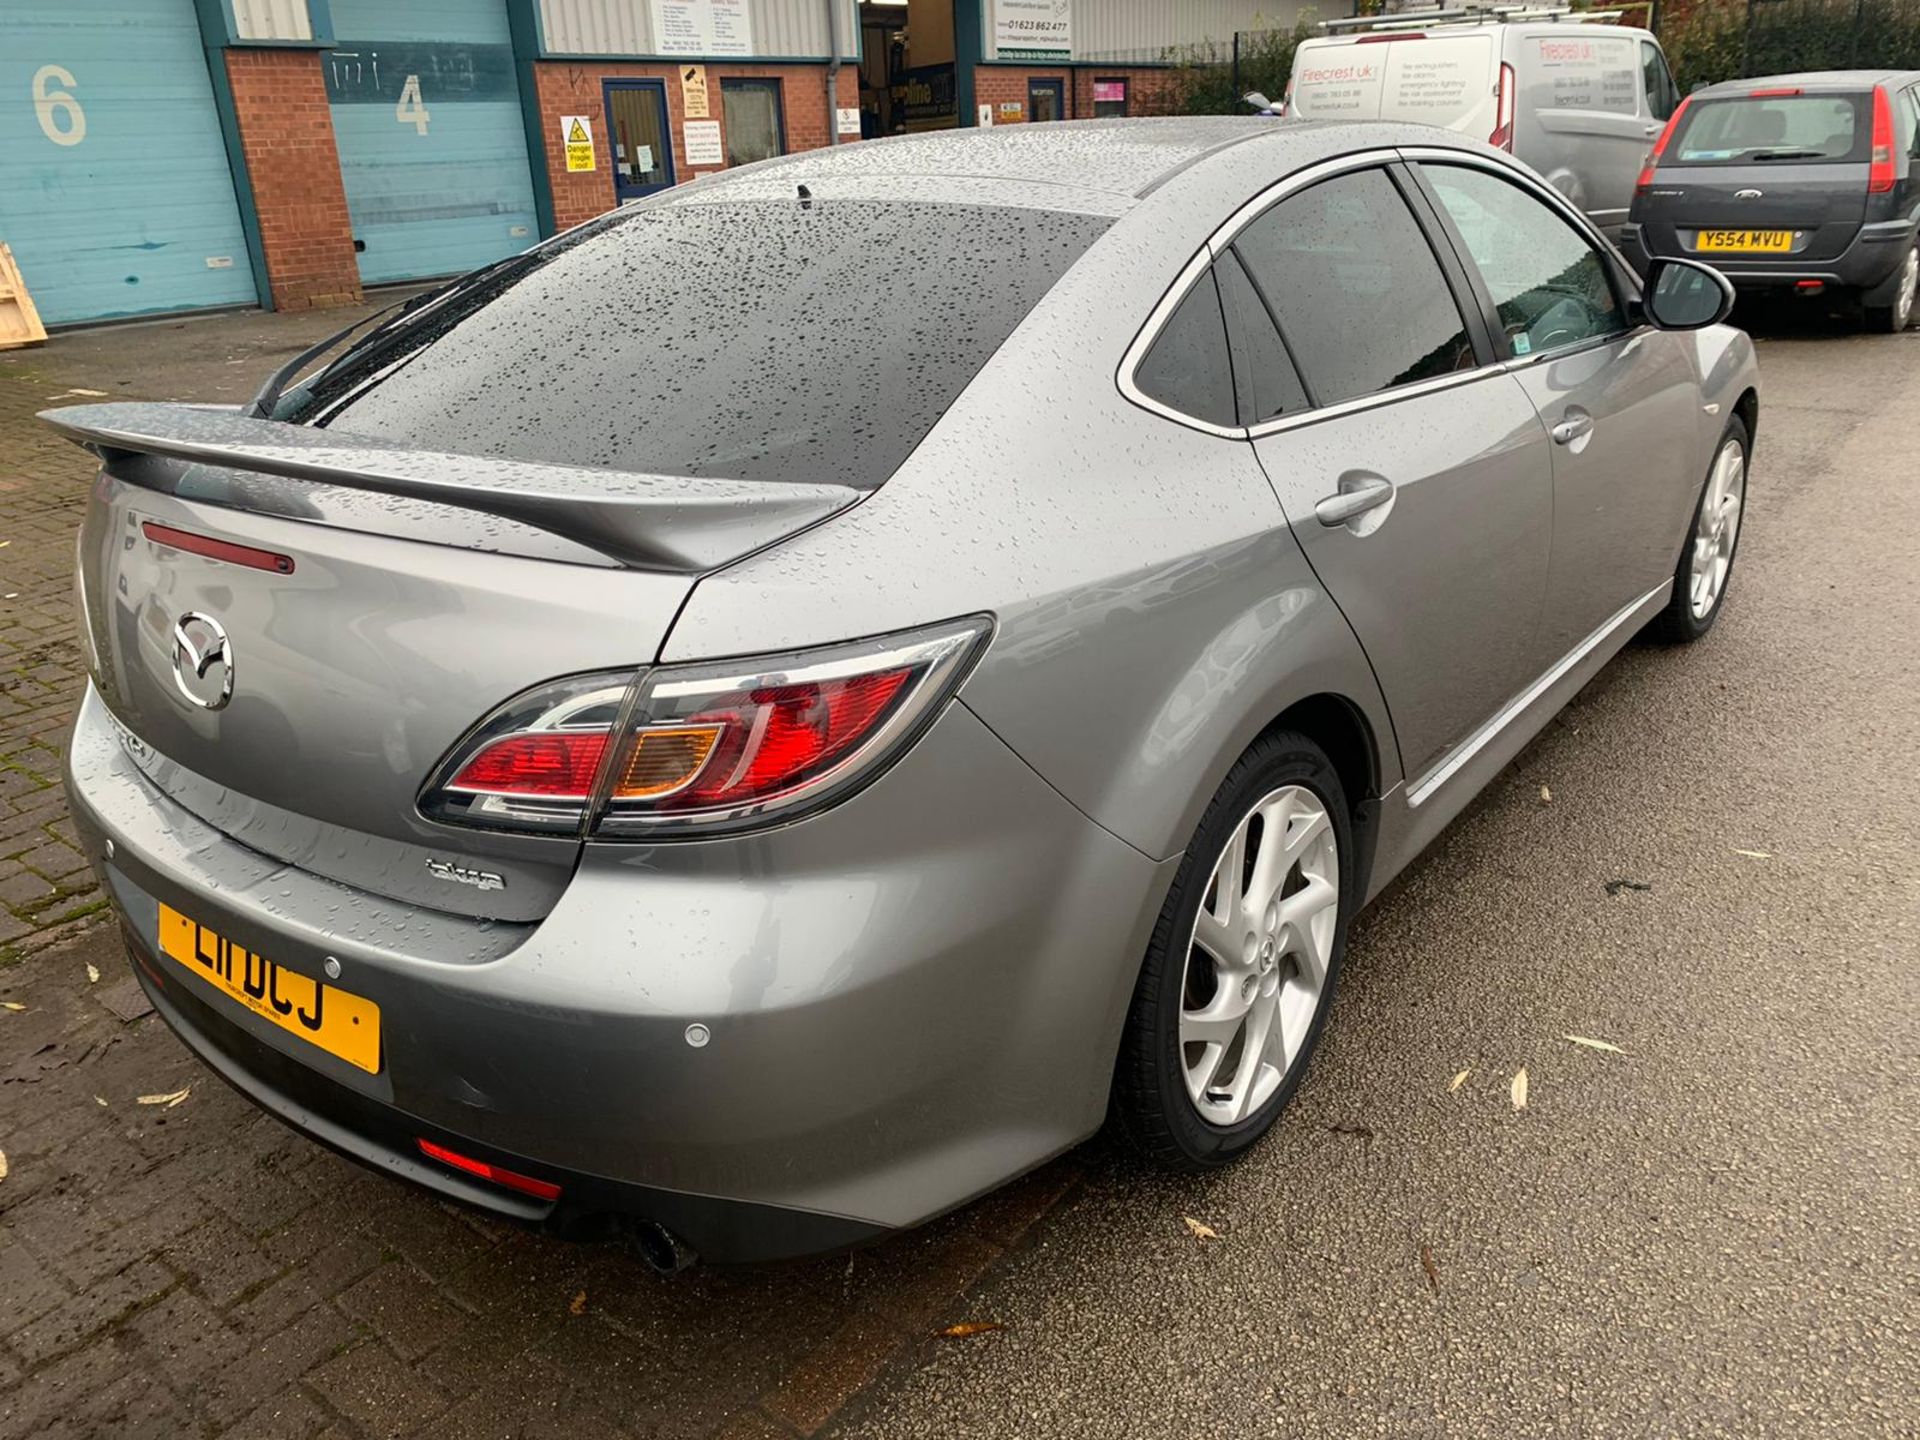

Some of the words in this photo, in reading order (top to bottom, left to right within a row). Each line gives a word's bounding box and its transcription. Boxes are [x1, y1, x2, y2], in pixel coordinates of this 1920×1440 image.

[1302, 66, 1354, 82] Firecrest
[1357, 64, 1372, 77] uk
[32, 64, 87, 147] 6
[396, 74, 431, 136] 4
[567, 144, 592, 153] Danger
[1706, 232, 1745, 247] YS54
[1750, 231, 1785, 247] MVU
